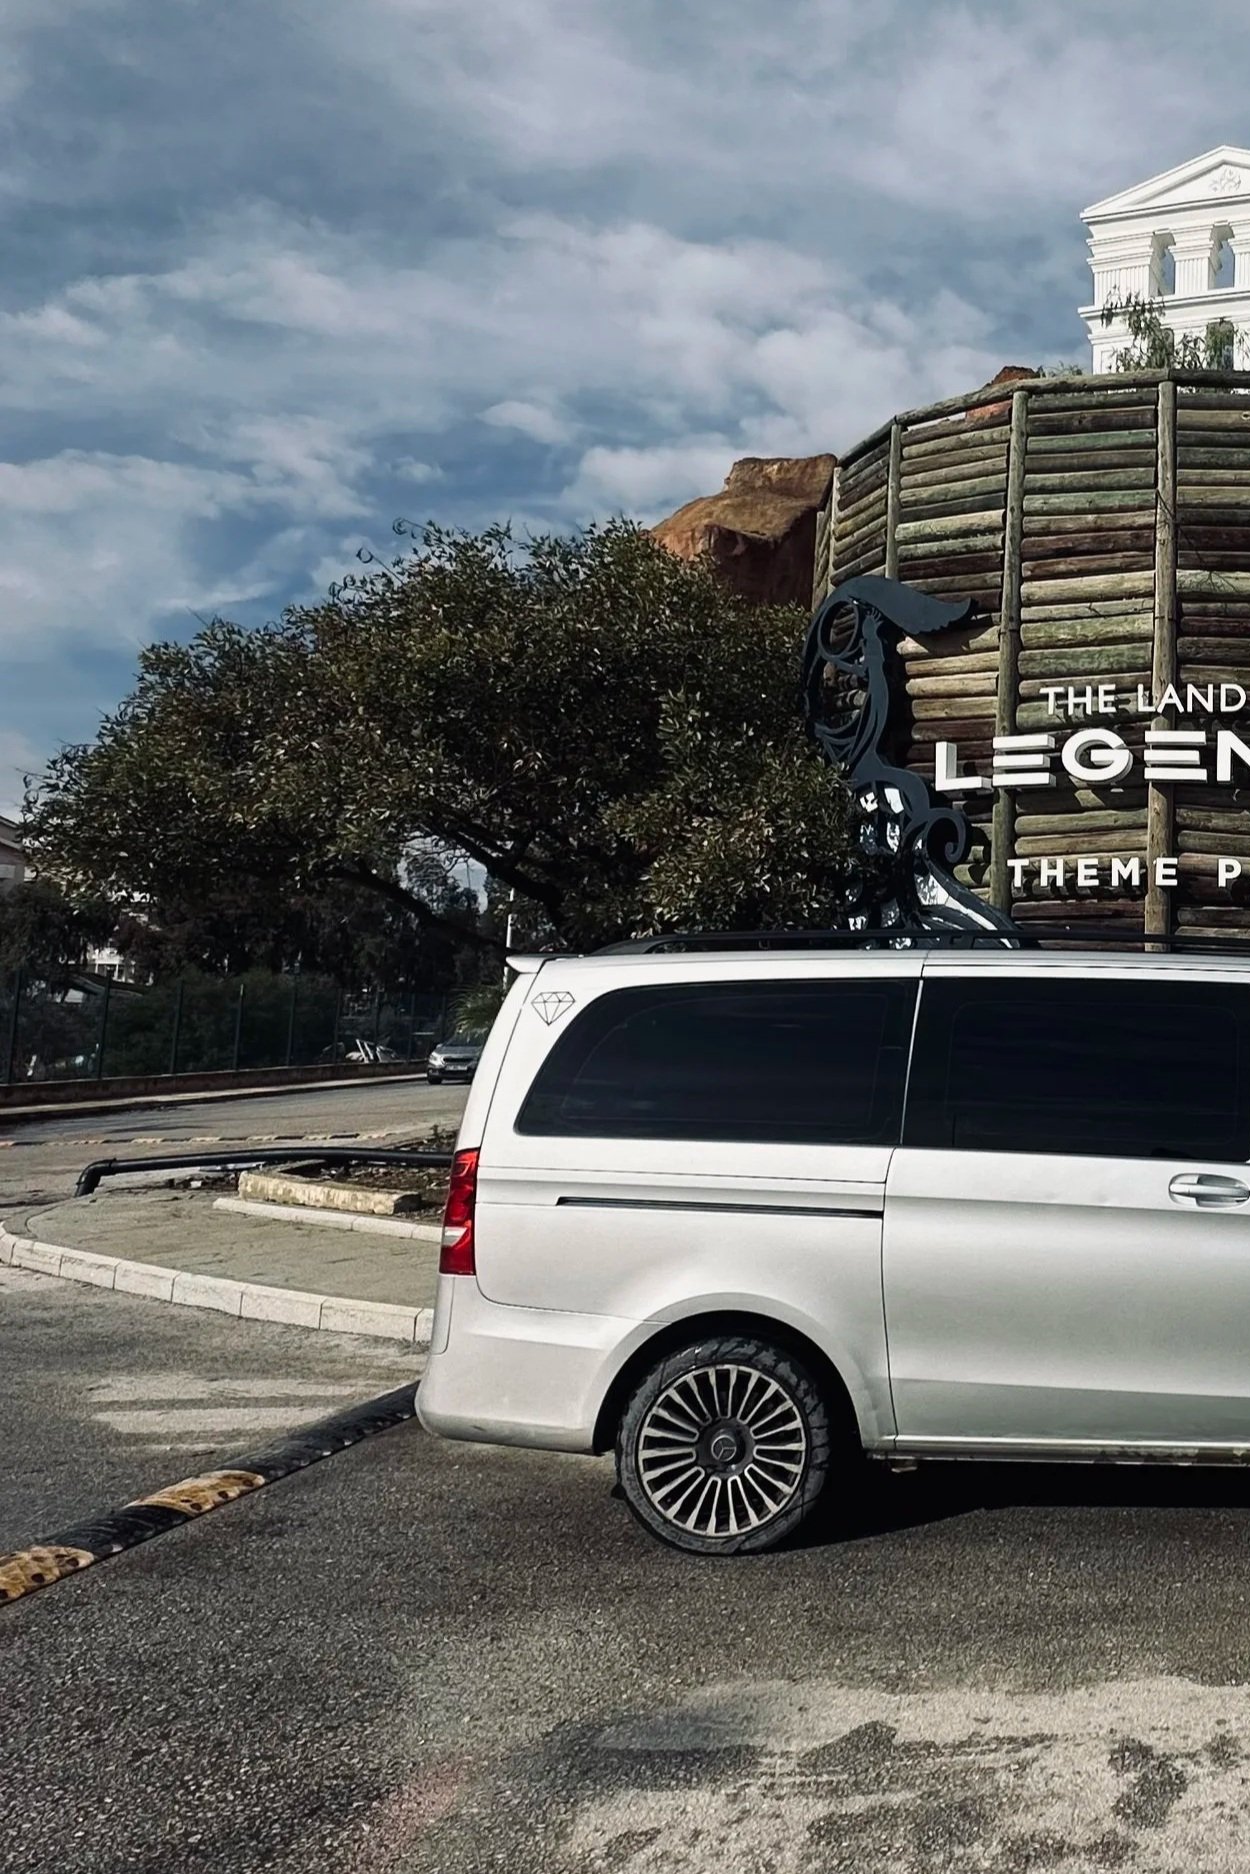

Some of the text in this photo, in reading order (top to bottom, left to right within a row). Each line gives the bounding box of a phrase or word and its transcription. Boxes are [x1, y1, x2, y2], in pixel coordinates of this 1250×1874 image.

[1039, 683, 1118, 716] THE
[1137, 683, 1247, 714] LAND
[1007, 856, 1179, 888] THEME
